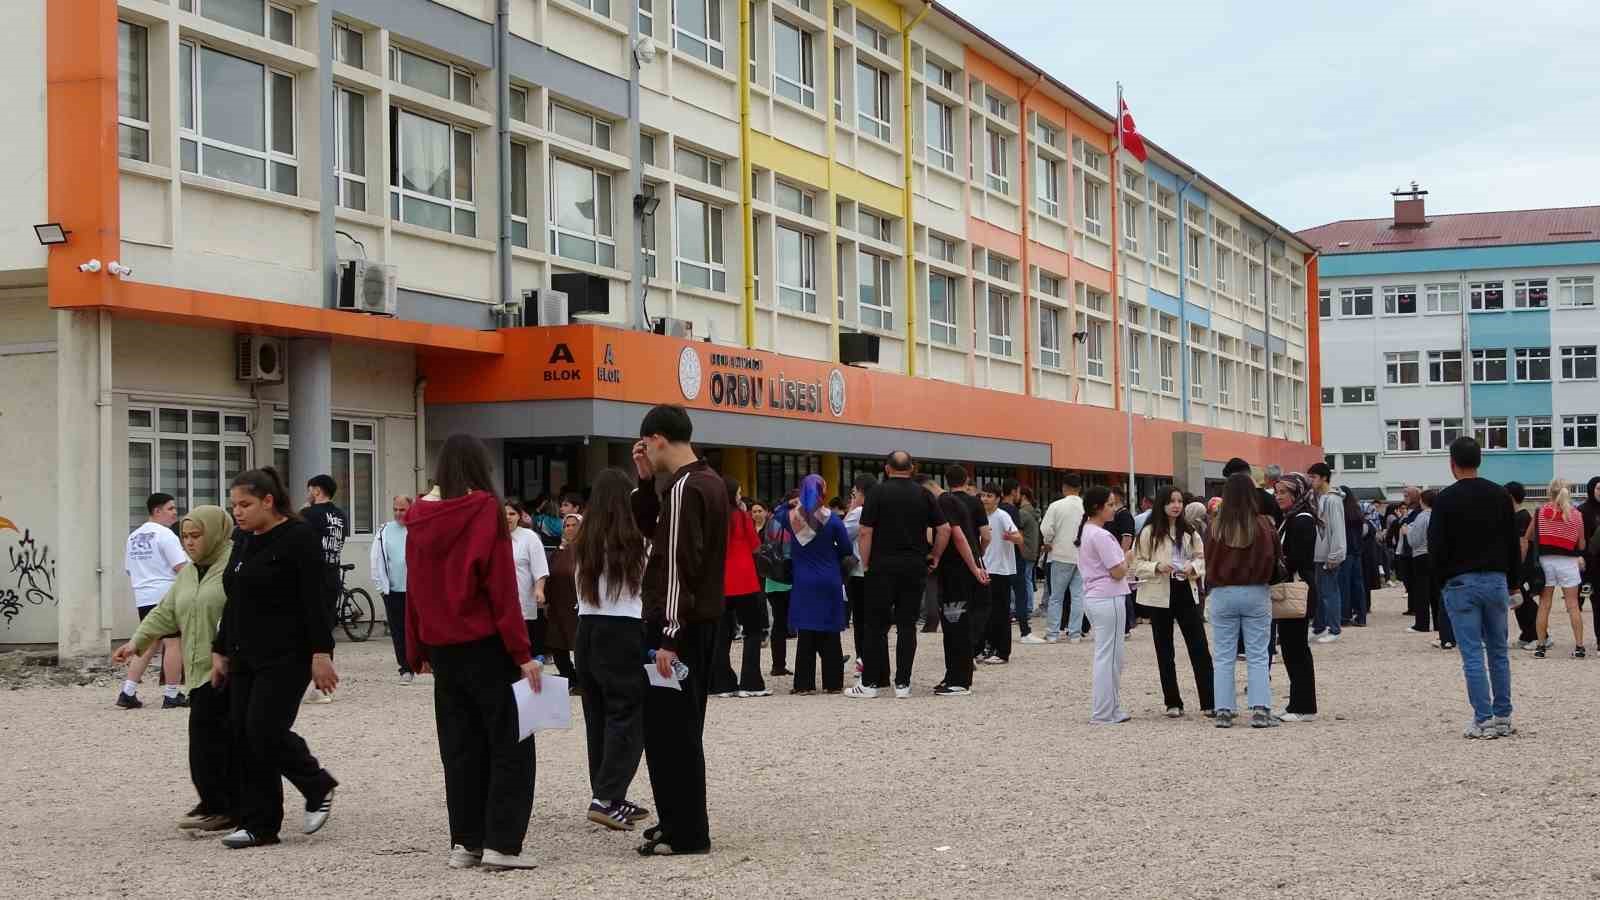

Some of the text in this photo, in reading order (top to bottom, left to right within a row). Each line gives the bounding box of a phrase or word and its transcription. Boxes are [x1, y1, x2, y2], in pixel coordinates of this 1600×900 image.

[549, 343, 575, 364] A
[603, 343, 614, 365] A
[543, 369, 581, 382] BLOK
[710, 371, 763, 409] ORDU
